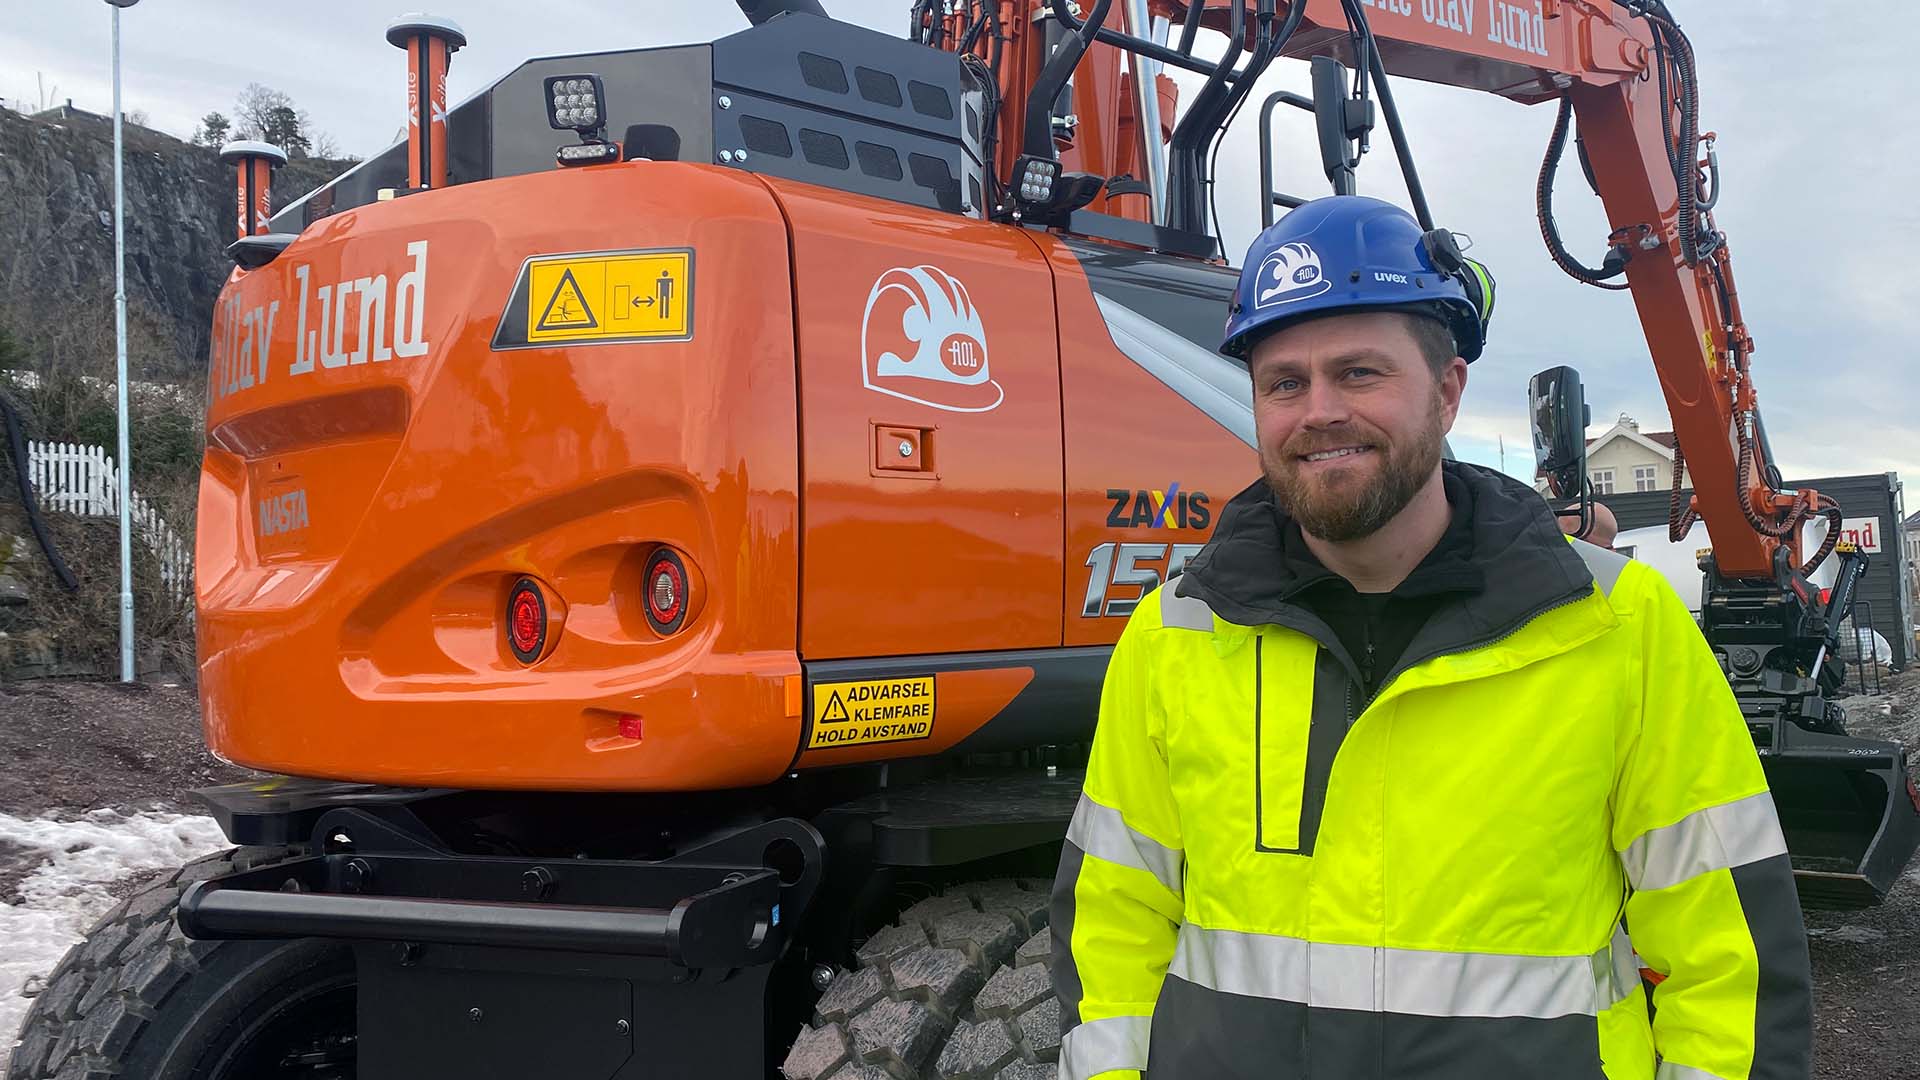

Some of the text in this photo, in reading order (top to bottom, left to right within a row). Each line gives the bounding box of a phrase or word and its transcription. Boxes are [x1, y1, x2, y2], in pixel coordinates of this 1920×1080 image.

[1487, 0, 1549, 57] Lund
[1297, 267, 1315, 281] AOL
[1374, 271, 1408, 284] uvex
[289, 240, 429, 376] Lund
[948, 340, 977, 368] AOL
[259, 489, 310, 537] NASTA
[1106, 481, 1211, 530] ZAXIS
[847, 682, 930, 702] ADVARSEL
[854, 703, 930, 722] KLEMFARE
[815, 722, 927, 743] HOLD AVSTAND
